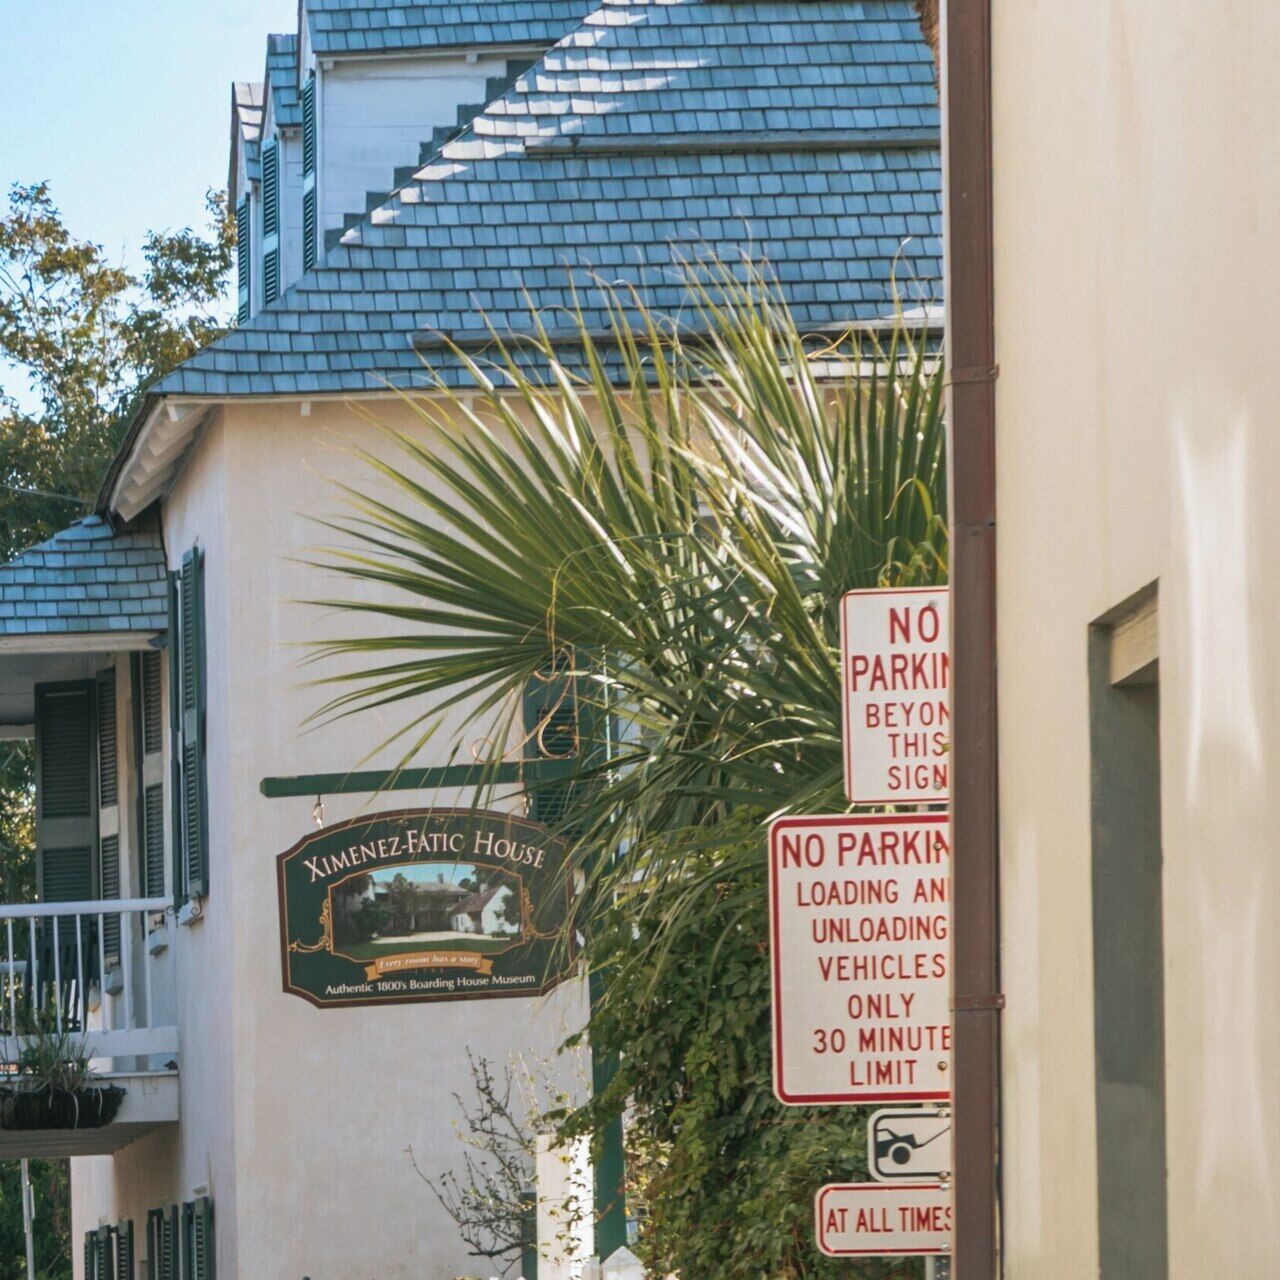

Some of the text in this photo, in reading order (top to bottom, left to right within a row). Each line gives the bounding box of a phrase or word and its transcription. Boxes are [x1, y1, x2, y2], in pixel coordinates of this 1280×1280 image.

[889, 605, 940, 644] NO
[888, 731, 946, 758] THIS
[887, 764, 948, 791] SIGN
[473, 830, 547, 869] HOUSE
[781, 833, 825, 869] NO
[797, 877, 950, 907] LOADING AN
[812, 916, 947, 943] UNLOADING
[818, 953, 946, 982] VEHICLES
[325, 973, 536, 996] Authentic 1800's Boarding House Museum
[848, 993, 915, 1019] ONLY
[813, 1025, 950, 1054] 30 MINUTE
[850, 1060, 917, 1086] LIMIT
[826, 1206, 951, 1233] AT ALL TIMES
